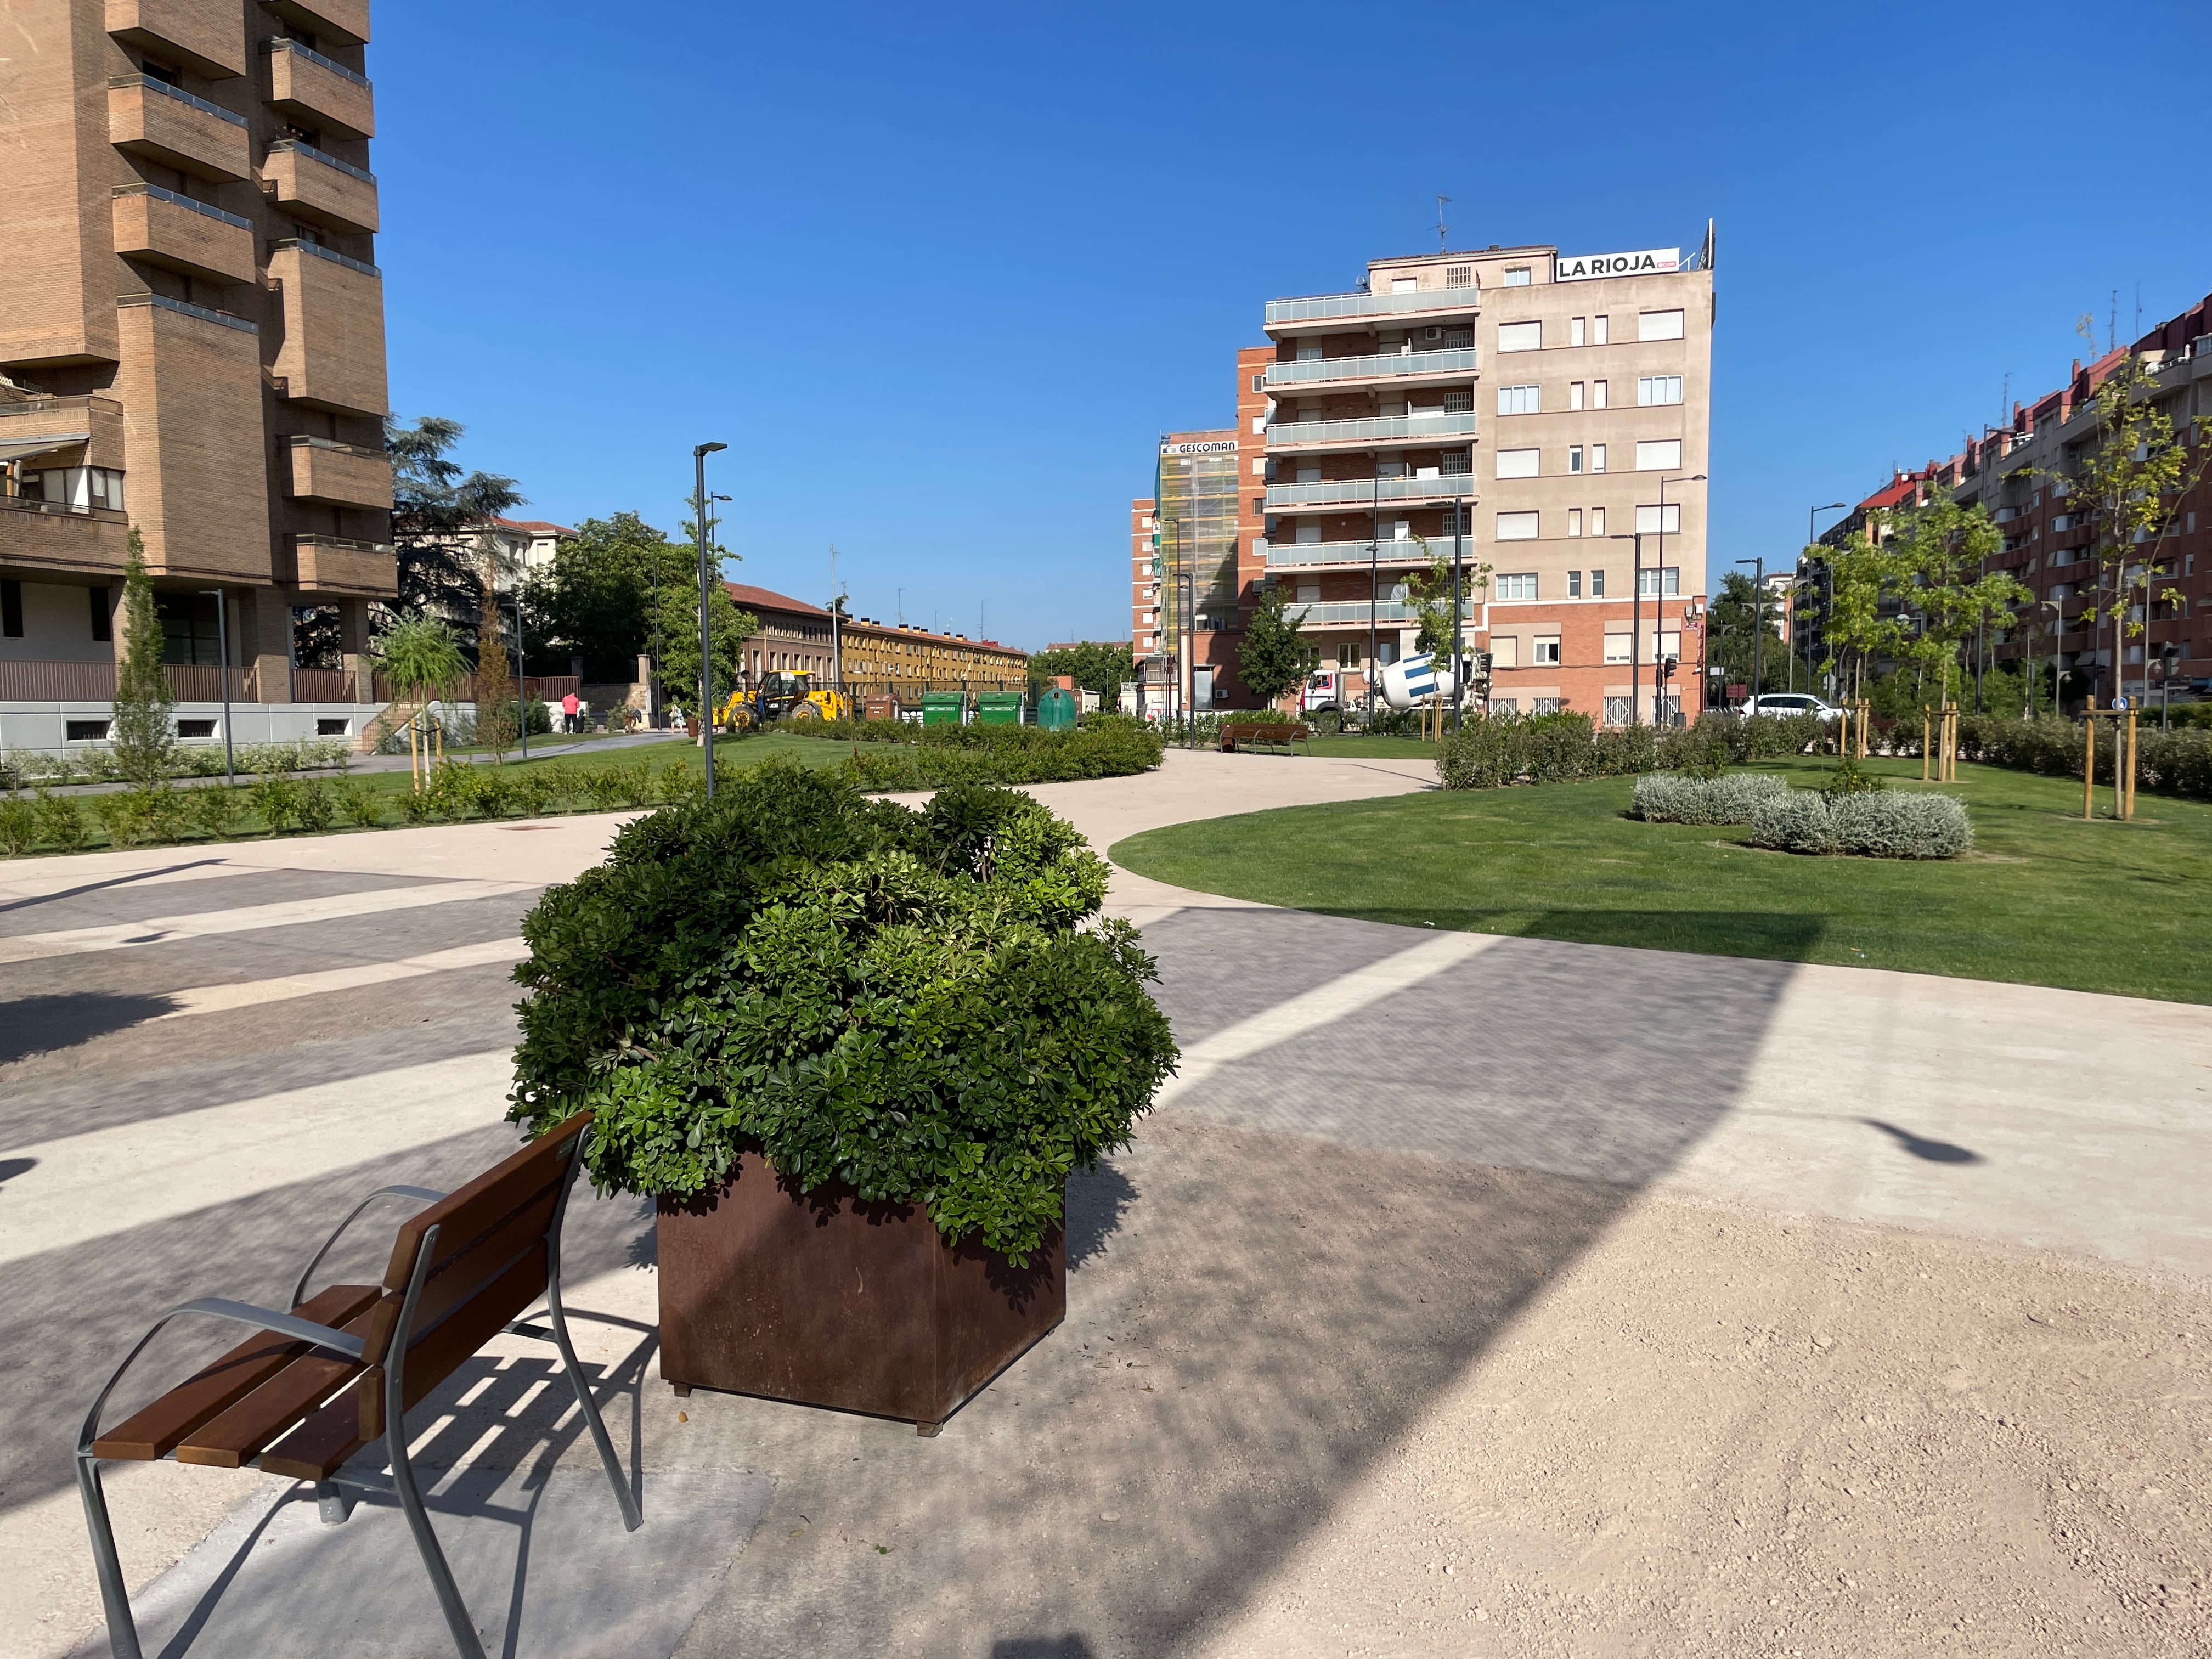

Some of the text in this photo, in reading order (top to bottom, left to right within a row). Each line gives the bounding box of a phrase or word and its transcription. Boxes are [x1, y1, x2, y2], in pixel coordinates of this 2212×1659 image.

[1559, 254, 1656, 277] LA RIOJA
[1180, 442, 1235, 453] GESCOMAN
